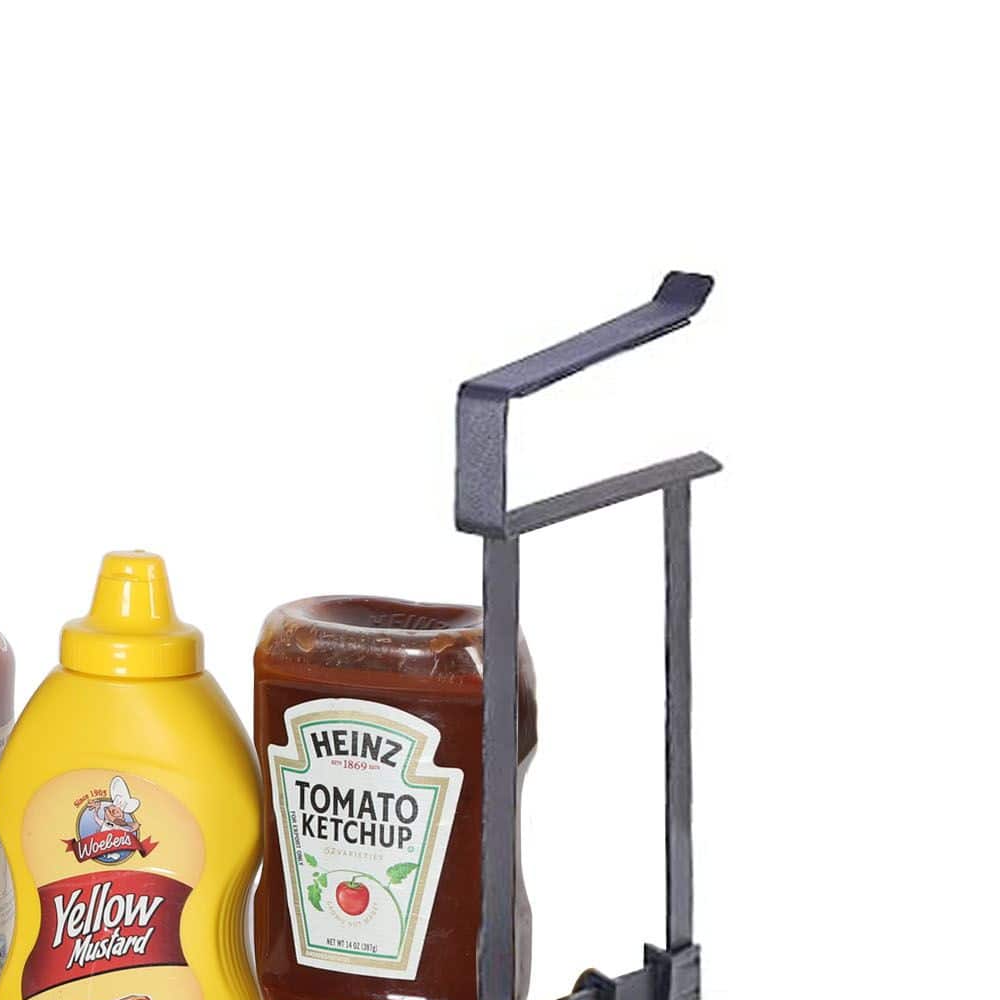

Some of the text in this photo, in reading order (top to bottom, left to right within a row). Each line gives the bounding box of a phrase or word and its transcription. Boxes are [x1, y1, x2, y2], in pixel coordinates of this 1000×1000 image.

[311, 730, 403, 767] HEINZ
[343, 759, 368, 770] 1869
[295, 780, 419, 824] TOMATO
[78, 831, 132, 859] Woeber's
[301, 813, 413, 849] KETCHUP
[52, 881, 165, 948] Yellow
[66, 927, 154, 970] Mustard
